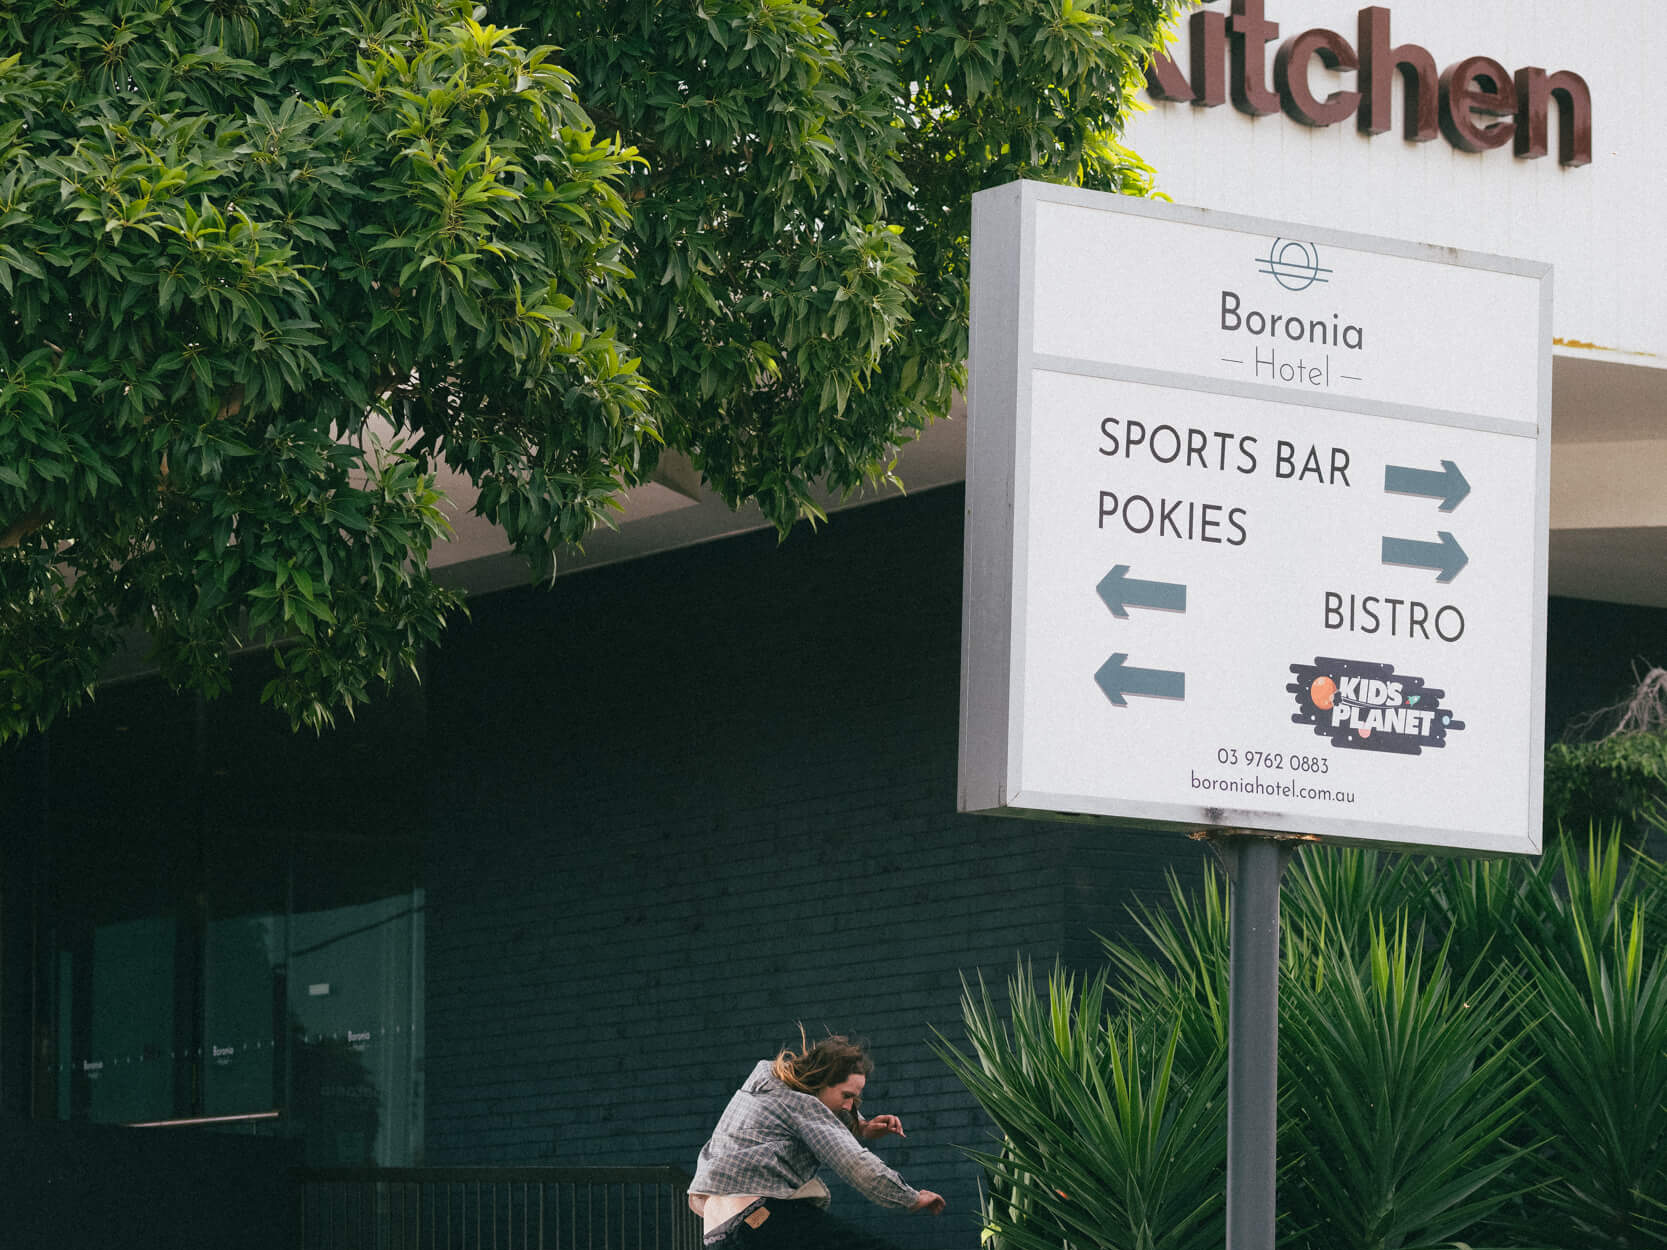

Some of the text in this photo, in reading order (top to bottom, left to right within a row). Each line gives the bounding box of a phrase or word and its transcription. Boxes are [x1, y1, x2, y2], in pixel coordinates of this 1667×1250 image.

[1140, 0, 1592, 167] itchen
[1221, 290, 1363, 350] Boronia
[1255, 345, 1329, 387] Hotel
[1098, 417, 1351, 487] SPORTS BAR
[1098, 490, 1247, 546] POKIES
[1324, 591, 1465, 643] BISTRO
[1331, 705, 1435, 736] PLANET
[1191, 769, 1355, 803] boroniahotel.com.au
[1217, 747, 1329, 774] 03 9762 0883
